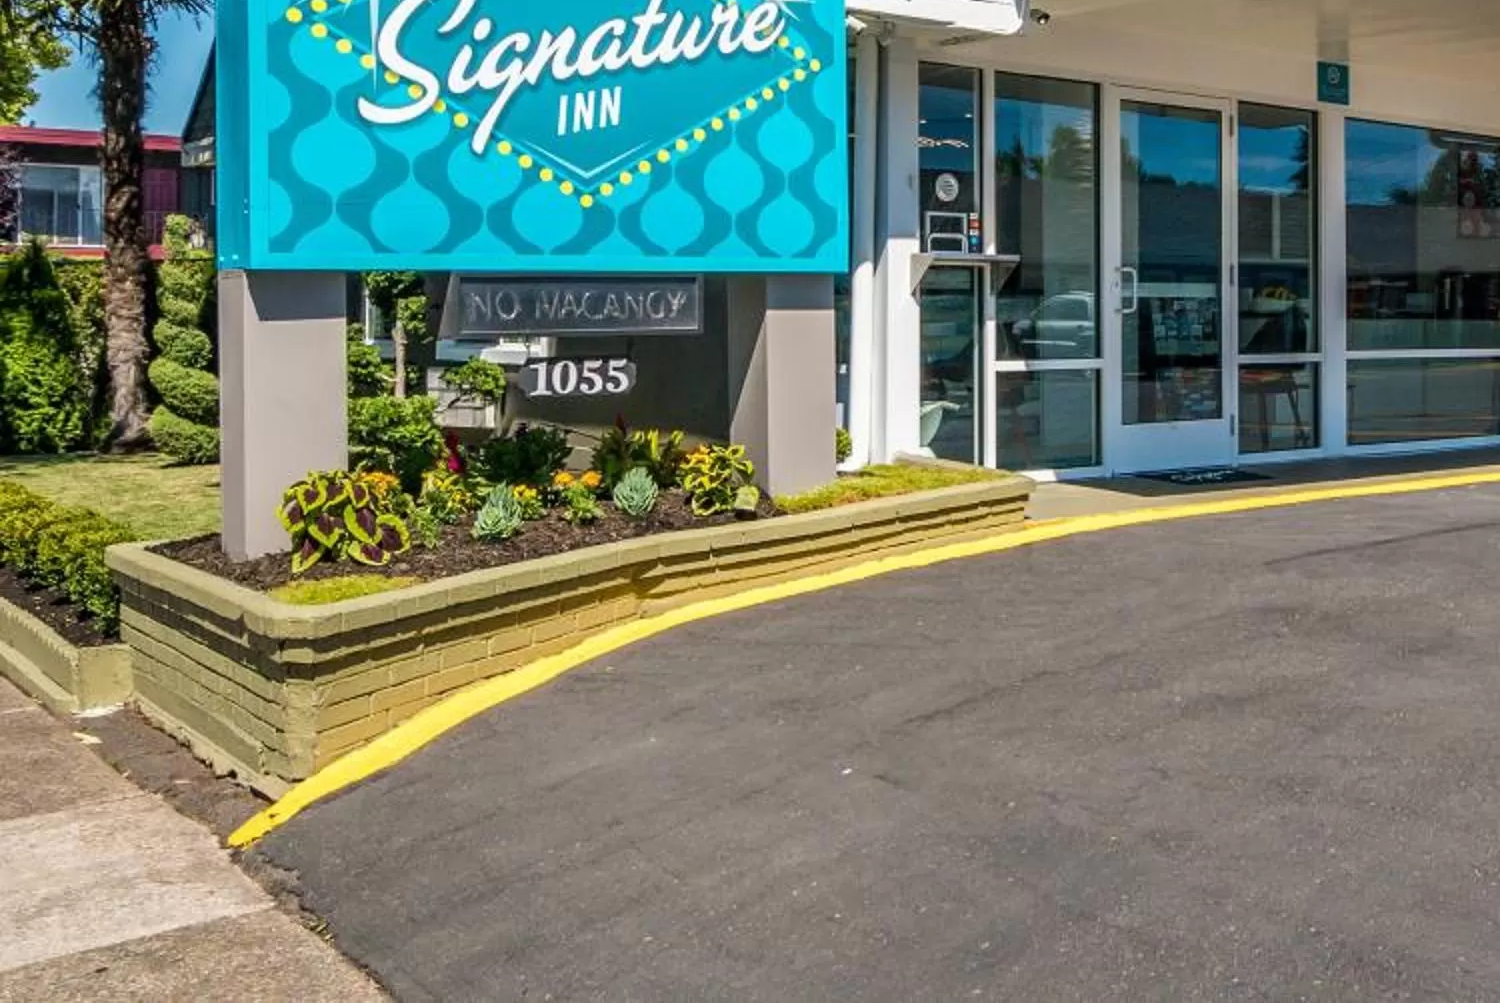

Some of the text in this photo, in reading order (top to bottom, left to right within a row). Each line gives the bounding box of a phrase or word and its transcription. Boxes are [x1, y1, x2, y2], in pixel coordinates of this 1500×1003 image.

[557, 86, 622, 136] INN
[470, 289, 688, 321] NO VACANCY
[529, 357, 630, 396] 1055
